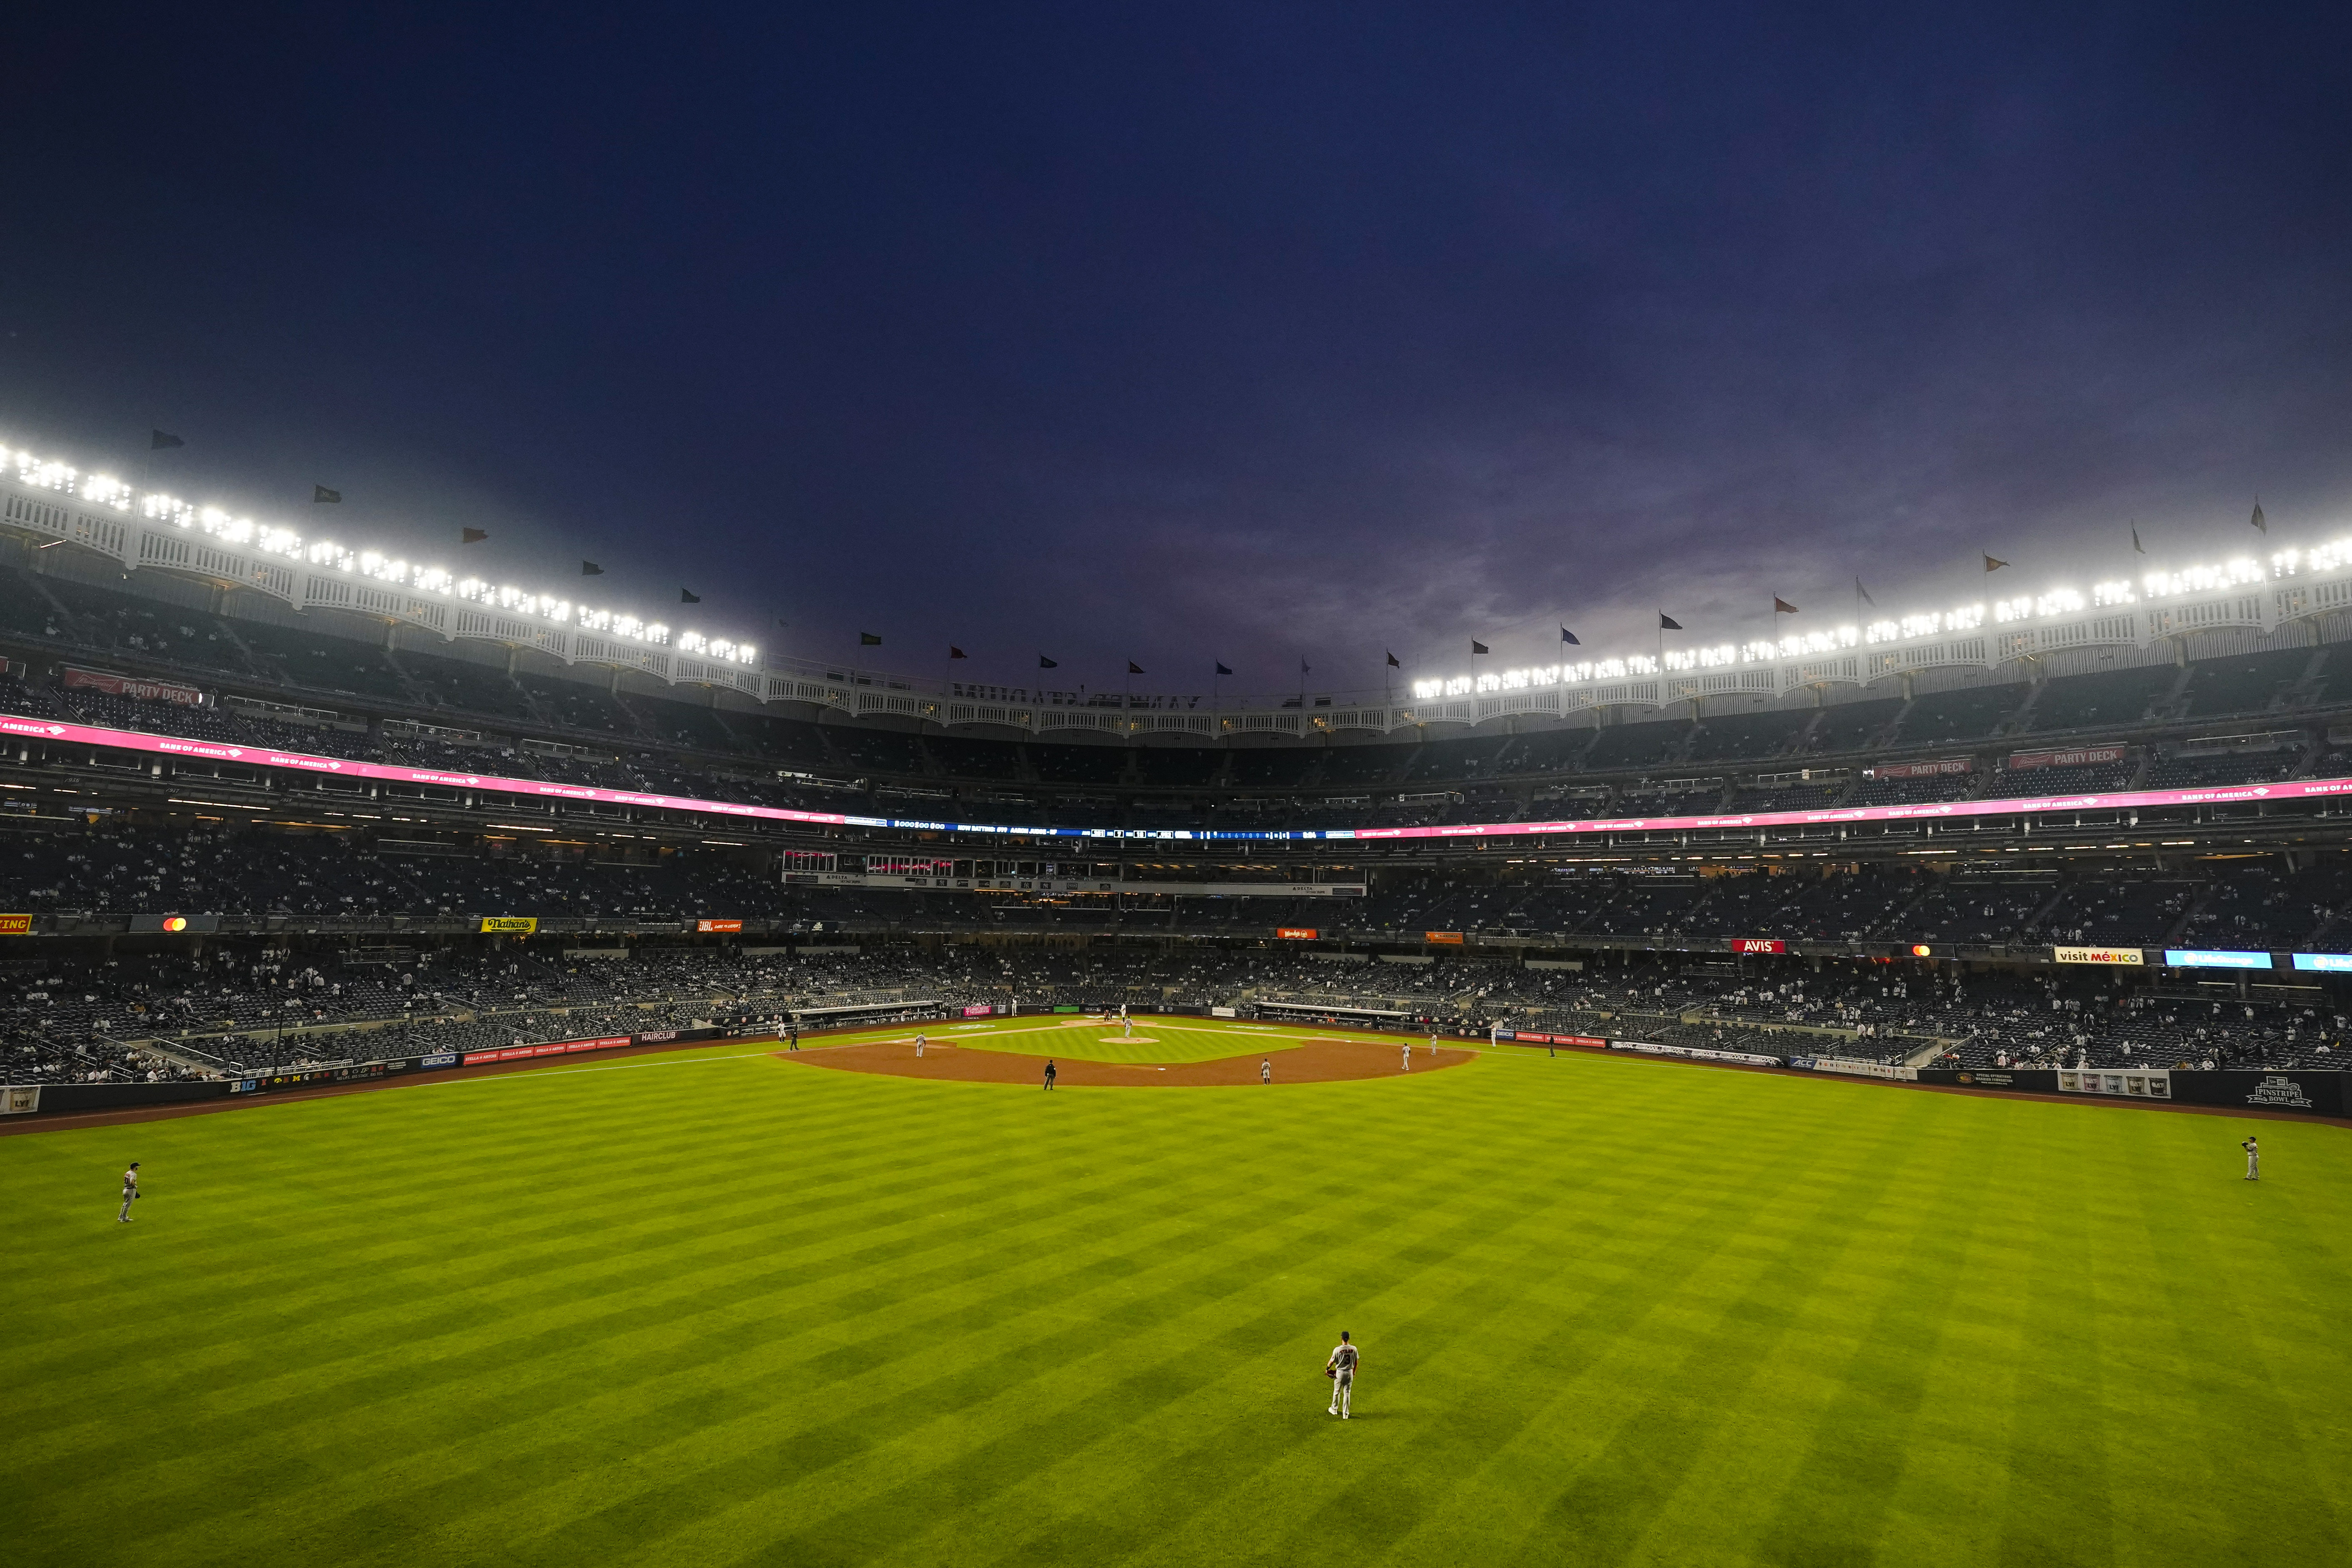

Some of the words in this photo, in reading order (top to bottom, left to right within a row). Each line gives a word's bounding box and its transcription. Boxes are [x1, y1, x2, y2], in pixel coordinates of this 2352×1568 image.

[122, 682, 159, 697] PARTY
[162, 688, 192, 704] DECK
[2, 723, 45, 733] AMERICA
[193, 747, 226, 756] AMERICA
[2055, 752, 2086, 764] PARTY
[2089, 750, 2117, 761] DECK
[299, 760, 327, 769] AMERICA
[1911, 764, 1939, 775] PARTY
[1940, 762, 1965, 773] DECK
[488, 918, 531, 929] Nathan's
[1744, 941, 1772, 952] AVIS
[2060, 951, 2088, 961] visit
[642, 1032, 676, 1041] HAIRCLUB
[422, 1055, 456, 1066] GEICO
[2258, 1088, 2300, 1098] PINSTRIPE
[1344, 1354, 1351, 1365] 3
